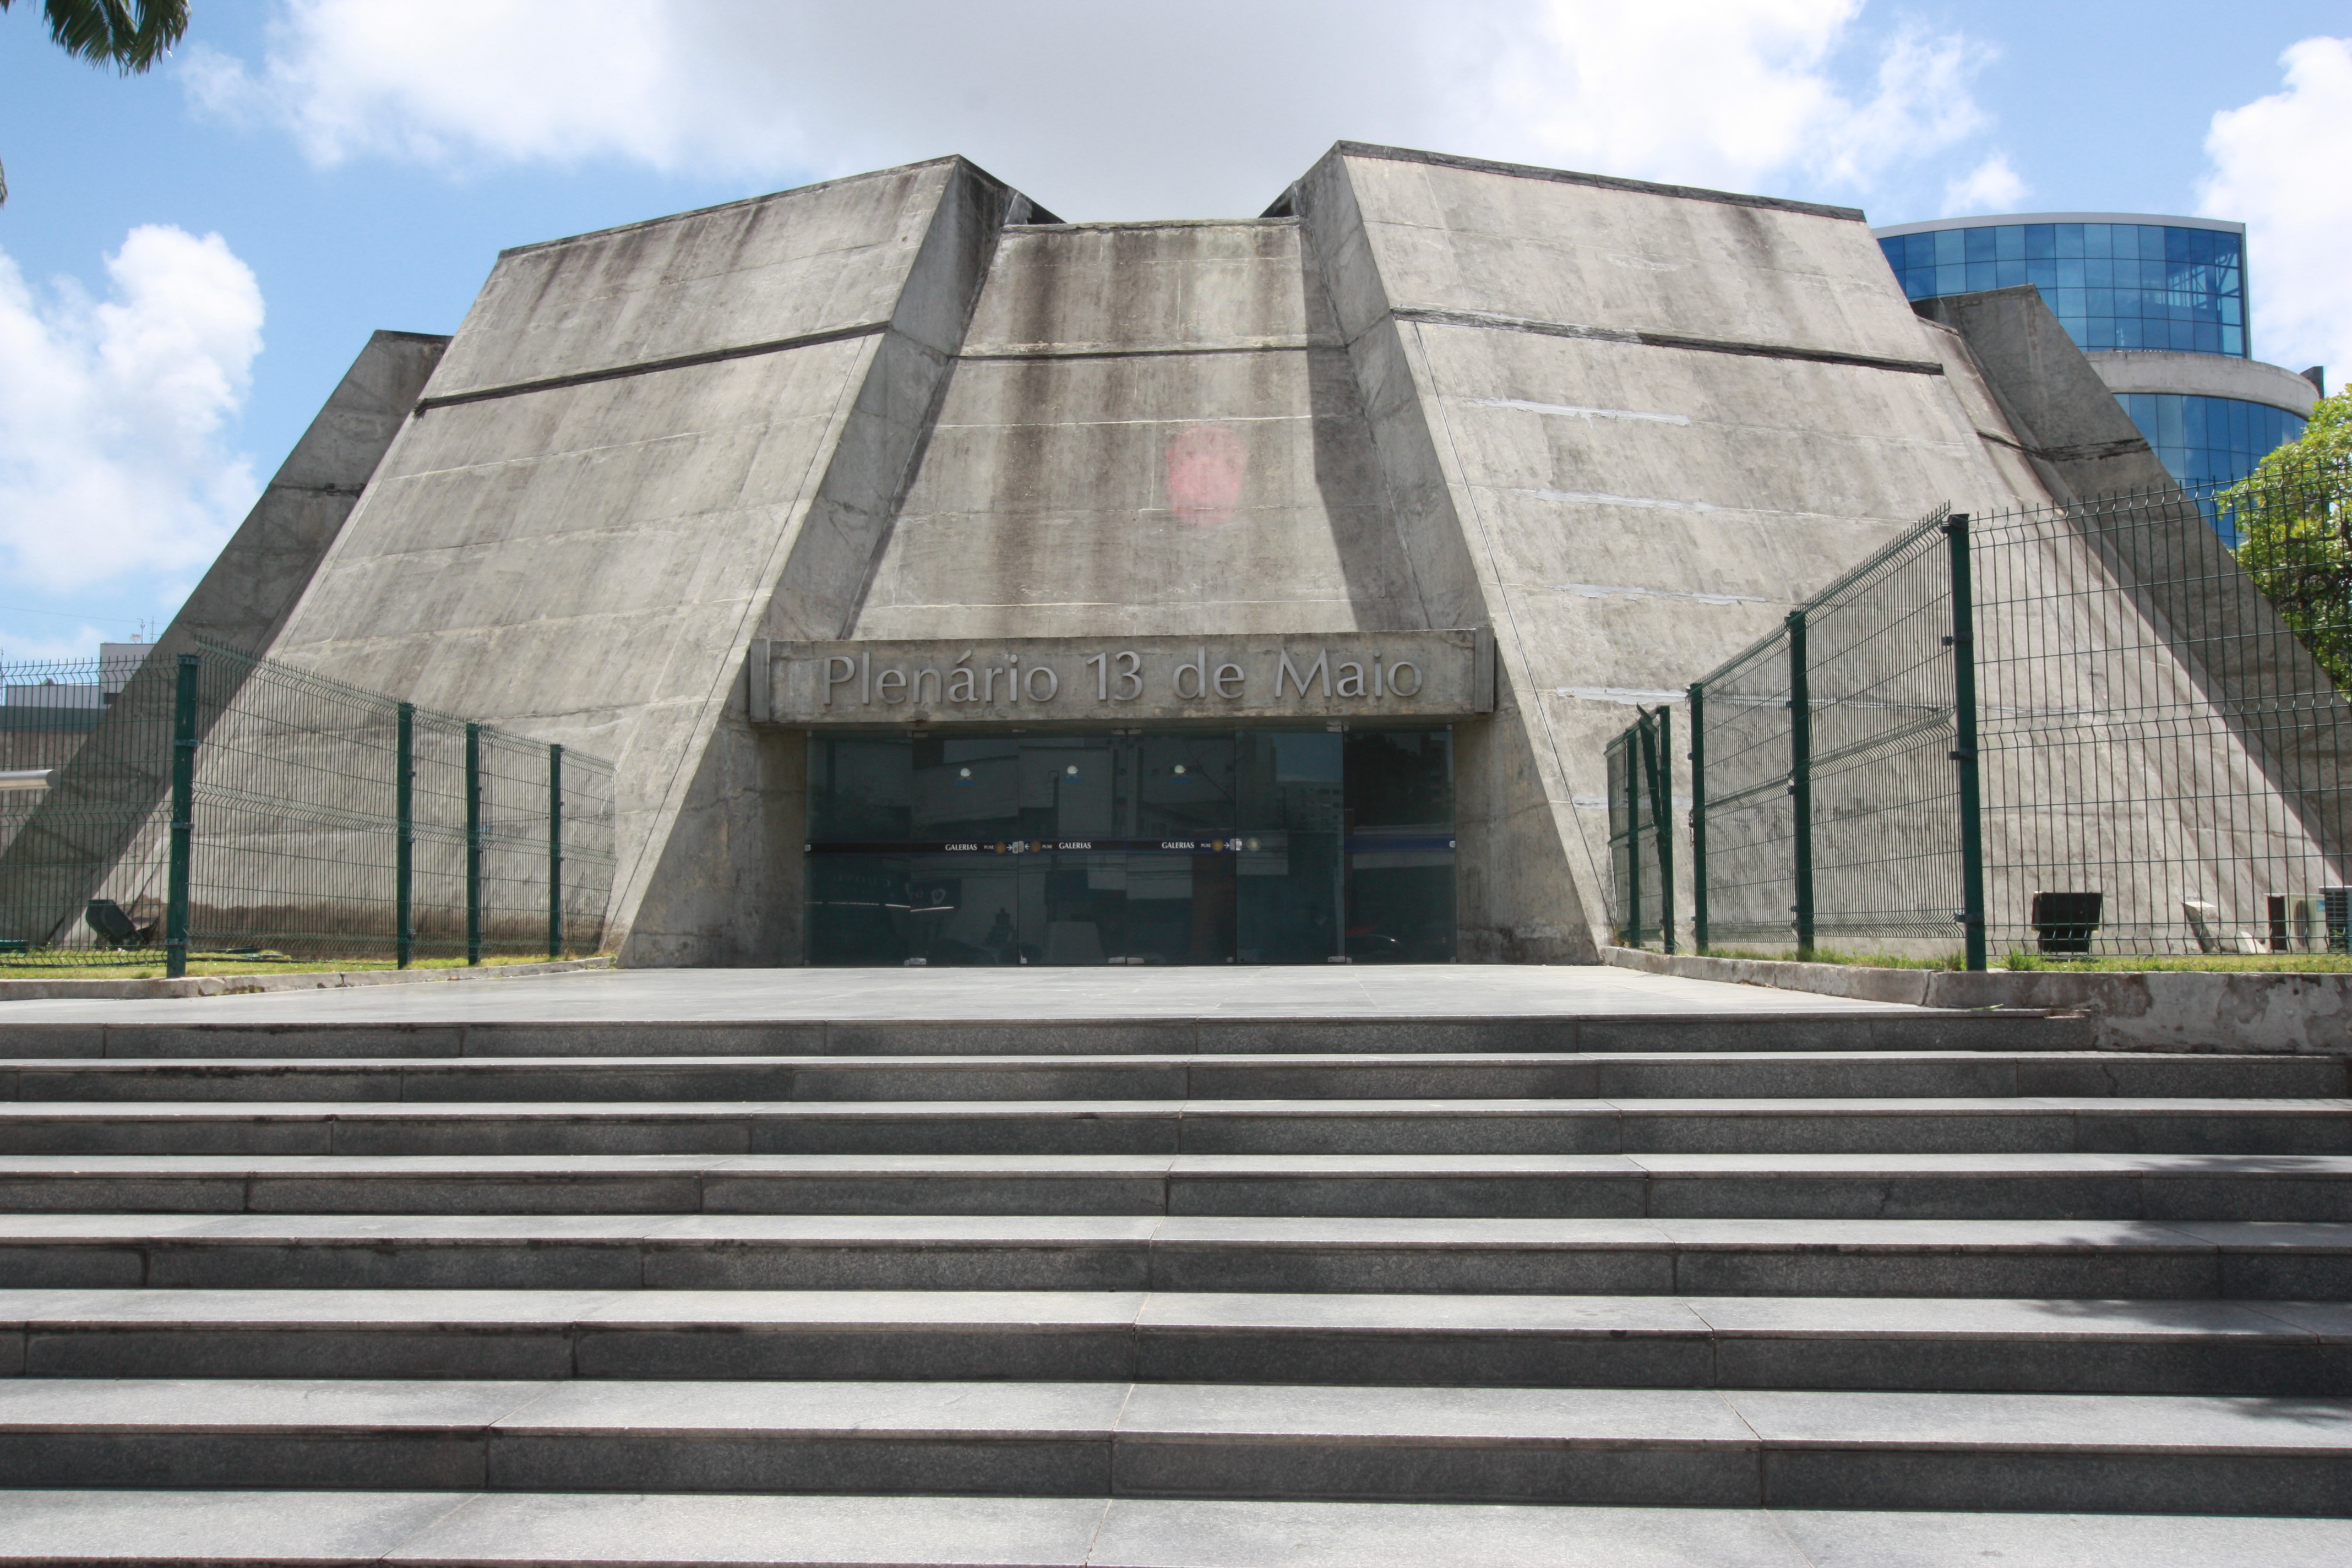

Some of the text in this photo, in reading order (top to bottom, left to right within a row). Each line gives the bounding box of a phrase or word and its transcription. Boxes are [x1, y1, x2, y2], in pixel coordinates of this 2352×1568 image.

[824, 646, 1422, 705] Plenário 13 de Maio
